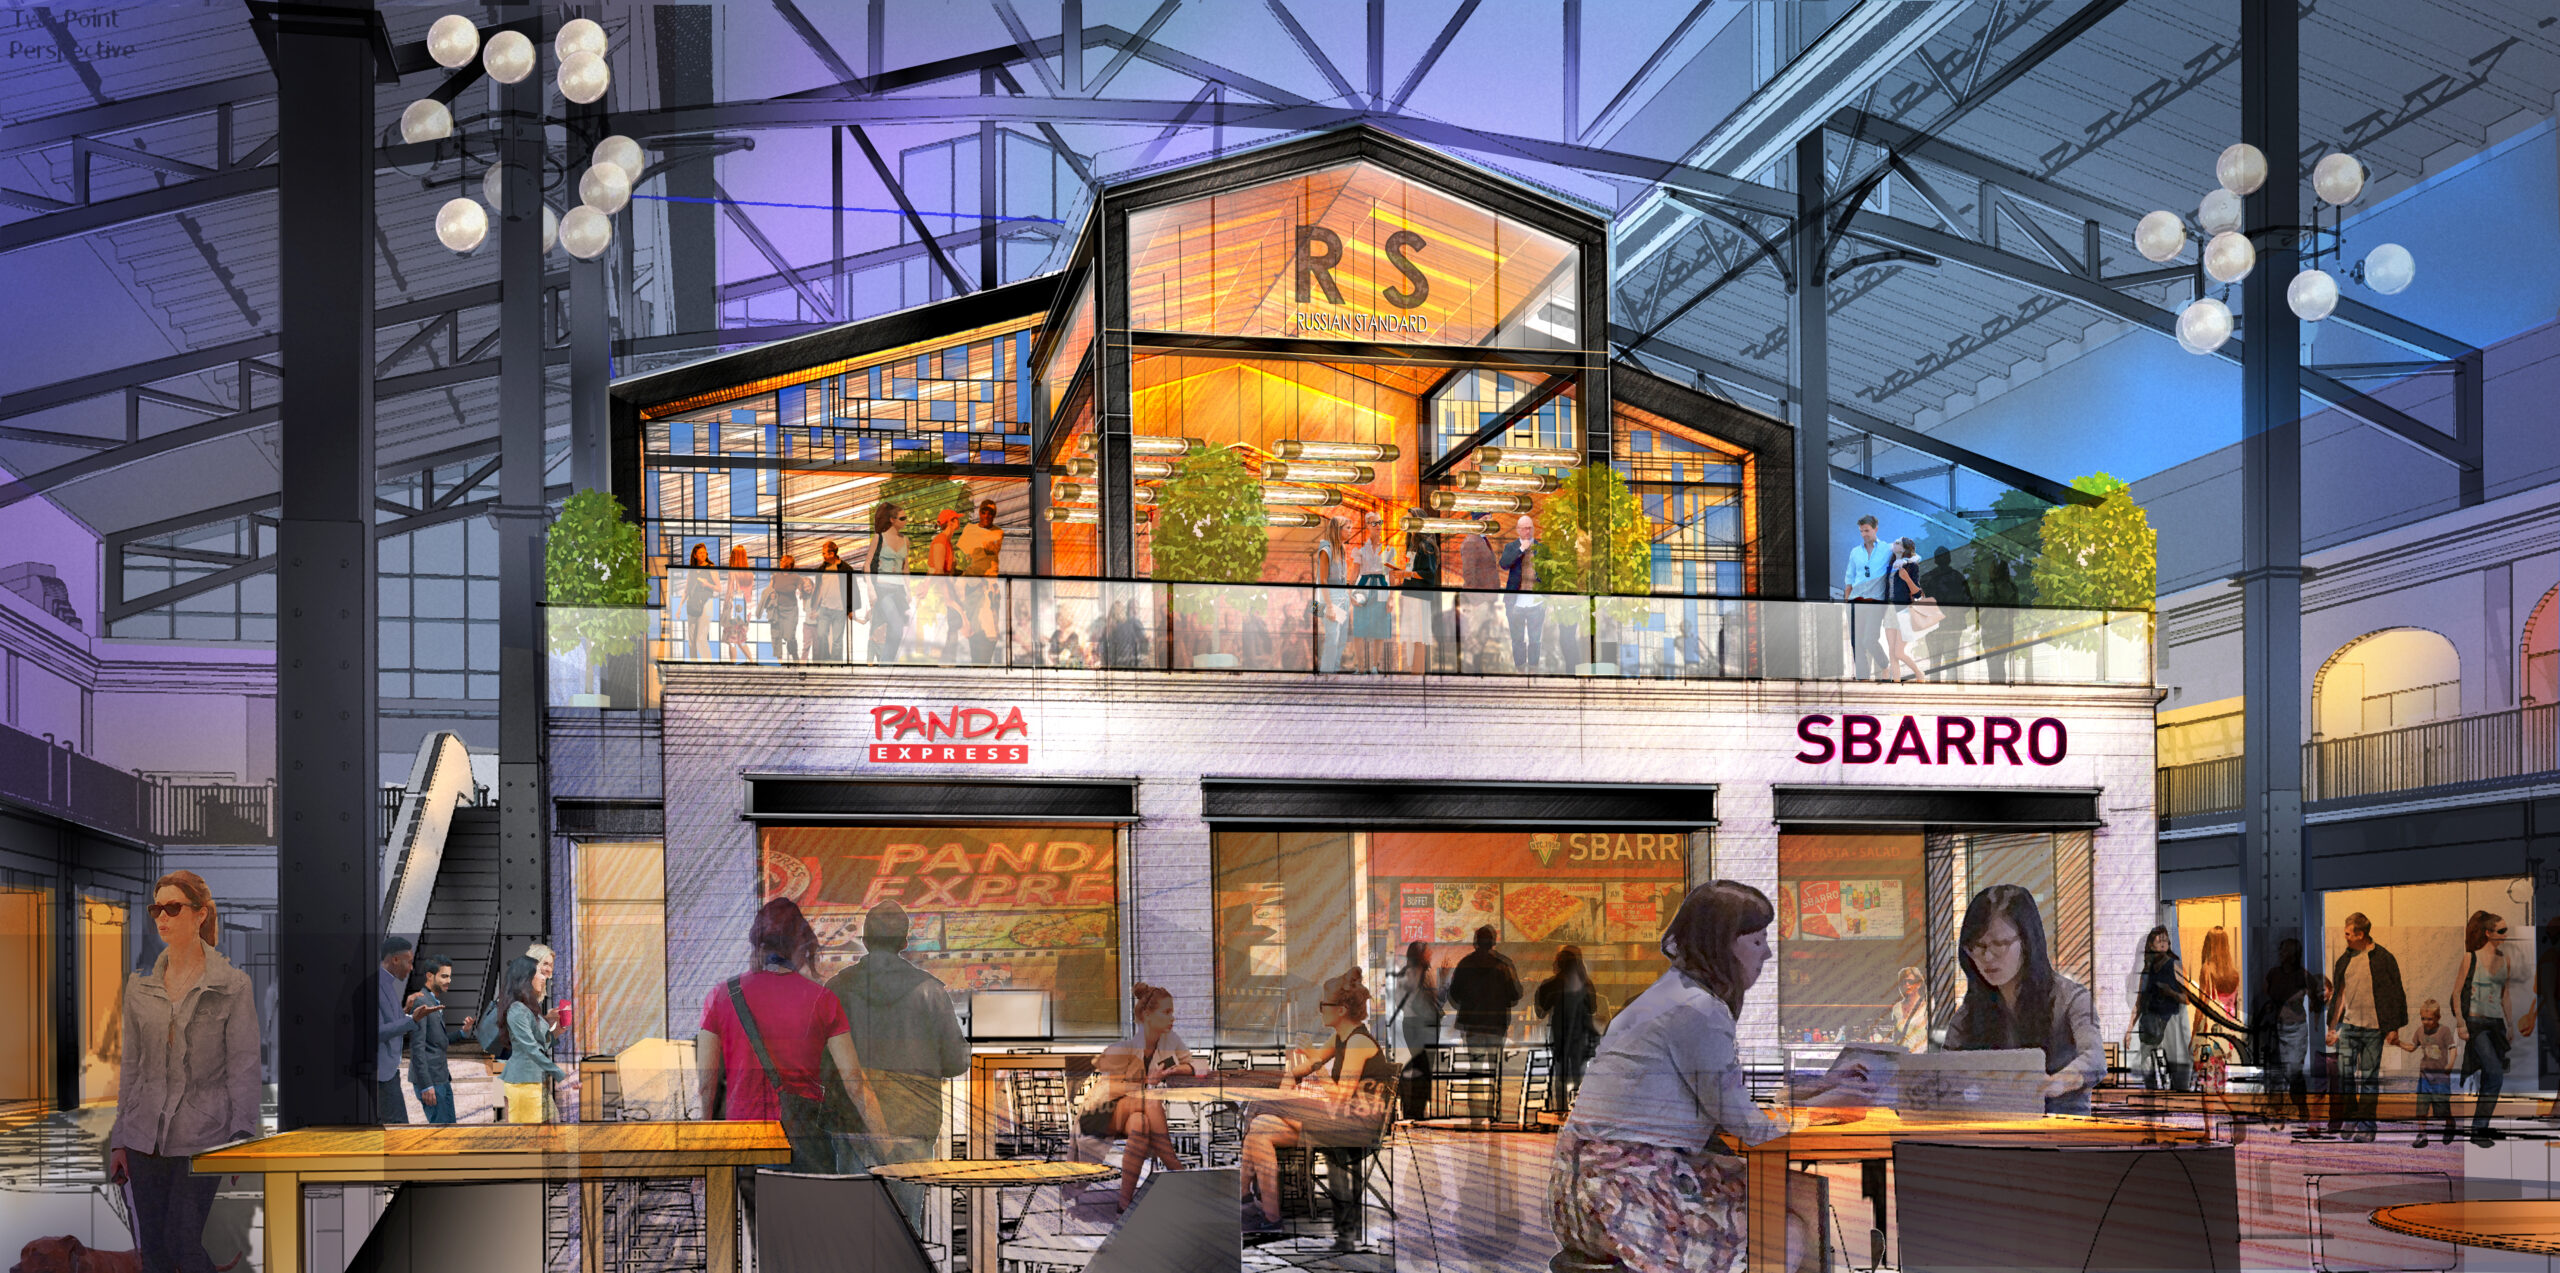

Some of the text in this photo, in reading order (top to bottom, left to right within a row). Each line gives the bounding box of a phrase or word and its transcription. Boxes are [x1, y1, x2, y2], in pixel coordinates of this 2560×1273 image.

[1295, 225, 1429, 309] R S
[1296, 312, 1427, 333] RUSSIAN STANDARD
[870, 705, 1028, 742] PANDA
[877, 747, 1020, 760] EXPRESS
[1795, 714, 2068, 766] SBARRO
[876, 841, 1119, 875] PAND
[1569, 833, 1685, 861] SBARR
[1859, 845, 1901, 858] SALAD
[861, 873, 1113, 909] EXPRE
[1801, 889, 1840, 909] SBARRO
